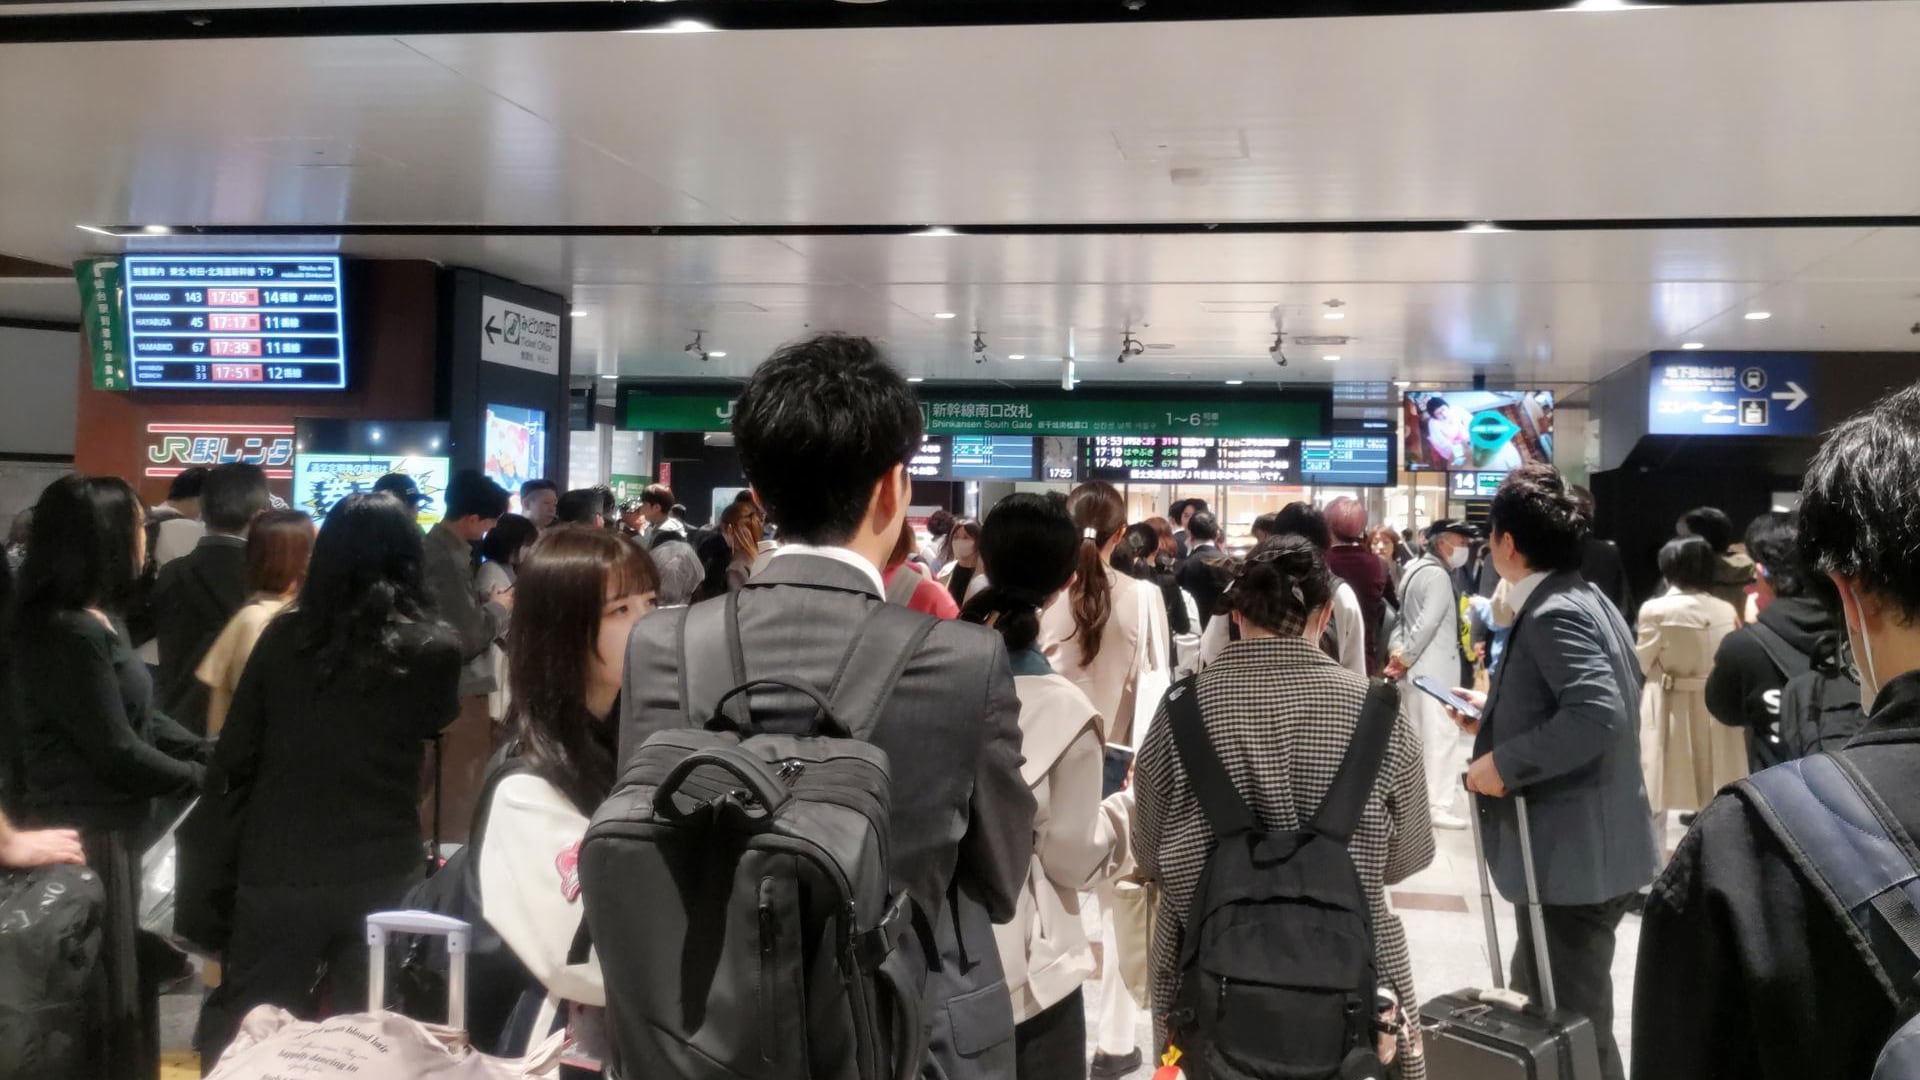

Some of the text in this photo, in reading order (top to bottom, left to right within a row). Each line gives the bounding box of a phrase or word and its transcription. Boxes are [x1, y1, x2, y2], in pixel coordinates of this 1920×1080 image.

[258, 267, 274, 276] 下り
[184, 292, 203, 302] 143
[211, 291, 248, 304] 17:05
[190, 317, 204, 328] 45
[212, 316, 248, 329] 17:17
[191, 342, 205, 353] 67
[214, 341, 250, 354] 17:39
[215, 366, 250, 379] 17:51
[932, 403, 1033, 419] 新幹線南口改札
[932, 420, 1033, 429] Shinkansen South Gate
[1096, 436, 1122, 446] 16:53
[148, 436, 294, 466] JR駅レンタ
[1095, 447, 1122, 457] 17:19
[1095, 459, 1122, 468] 17:40
[1455, 473, 1475, 489] 14
